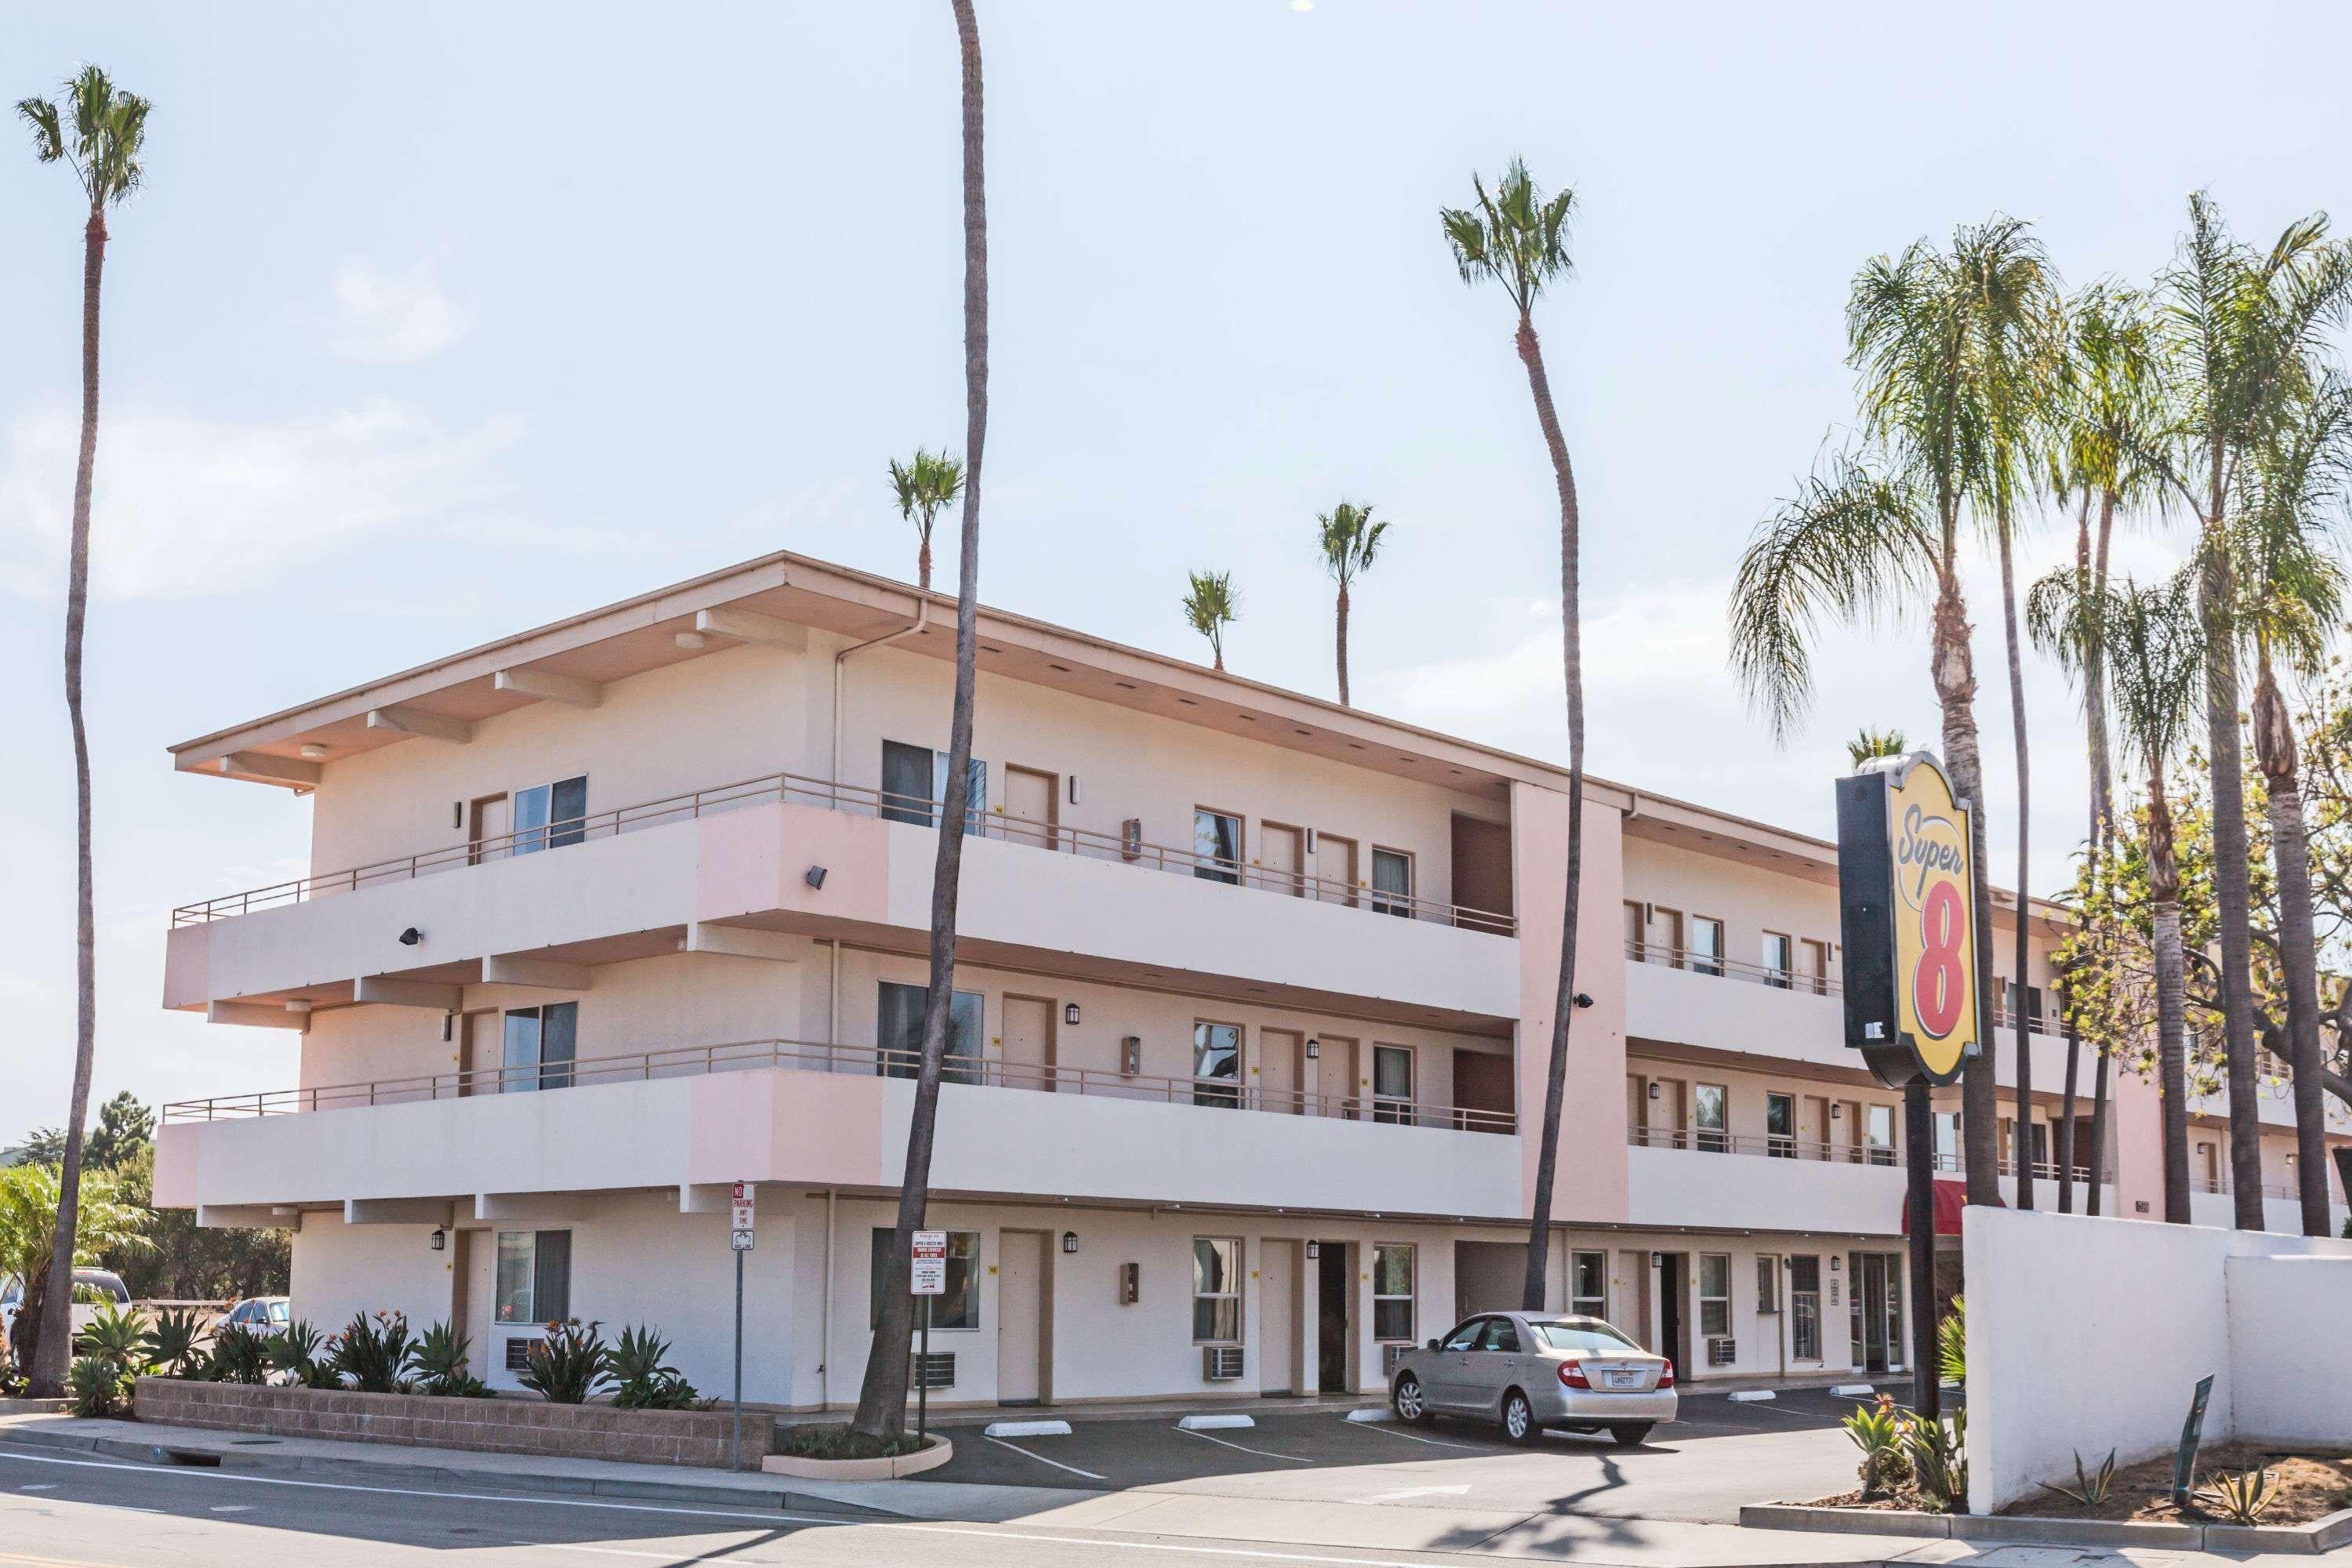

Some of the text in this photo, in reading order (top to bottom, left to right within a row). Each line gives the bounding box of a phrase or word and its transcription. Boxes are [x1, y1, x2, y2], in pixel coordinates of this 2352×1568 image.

[1897, 804, 1964, 900] Super
[1913, 880, 1965, 1041] 8
[734, 1186, 742, 1197] NO
